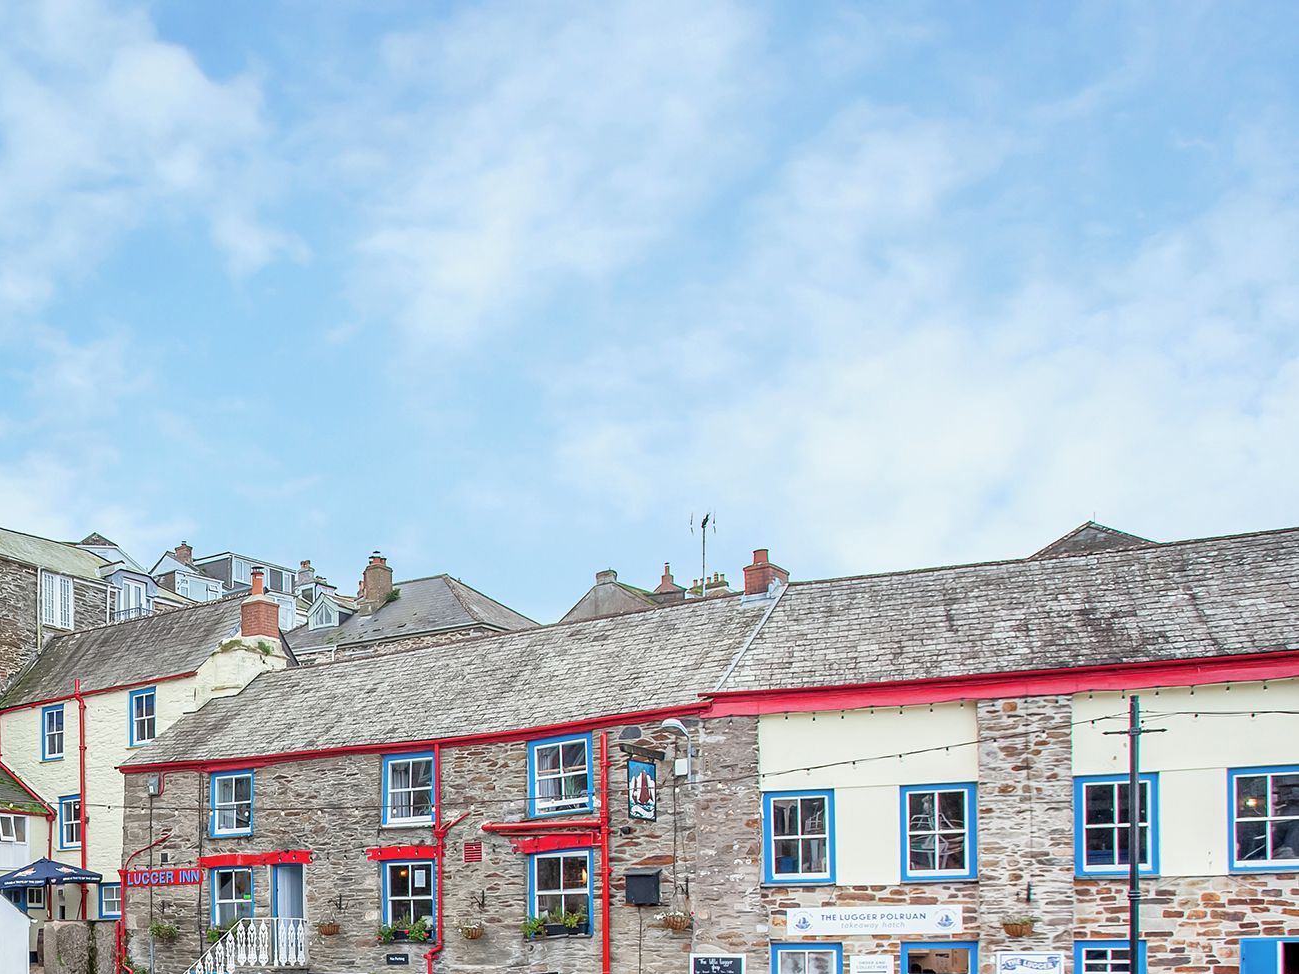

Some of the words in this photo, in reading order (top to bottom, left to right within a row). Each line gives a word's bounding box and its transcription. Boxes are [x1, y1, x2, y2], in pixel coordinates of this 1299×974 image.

[179, 869, 200, 883] INN
[840, 913, 877, 921] LUGGER
[880, 912, 927, 920] POLRUAN
[840, 922, 879, 930] takeaway
[882, 921, 906, 929] hatch
[1023, 960, 1053, 970] LUGGER
